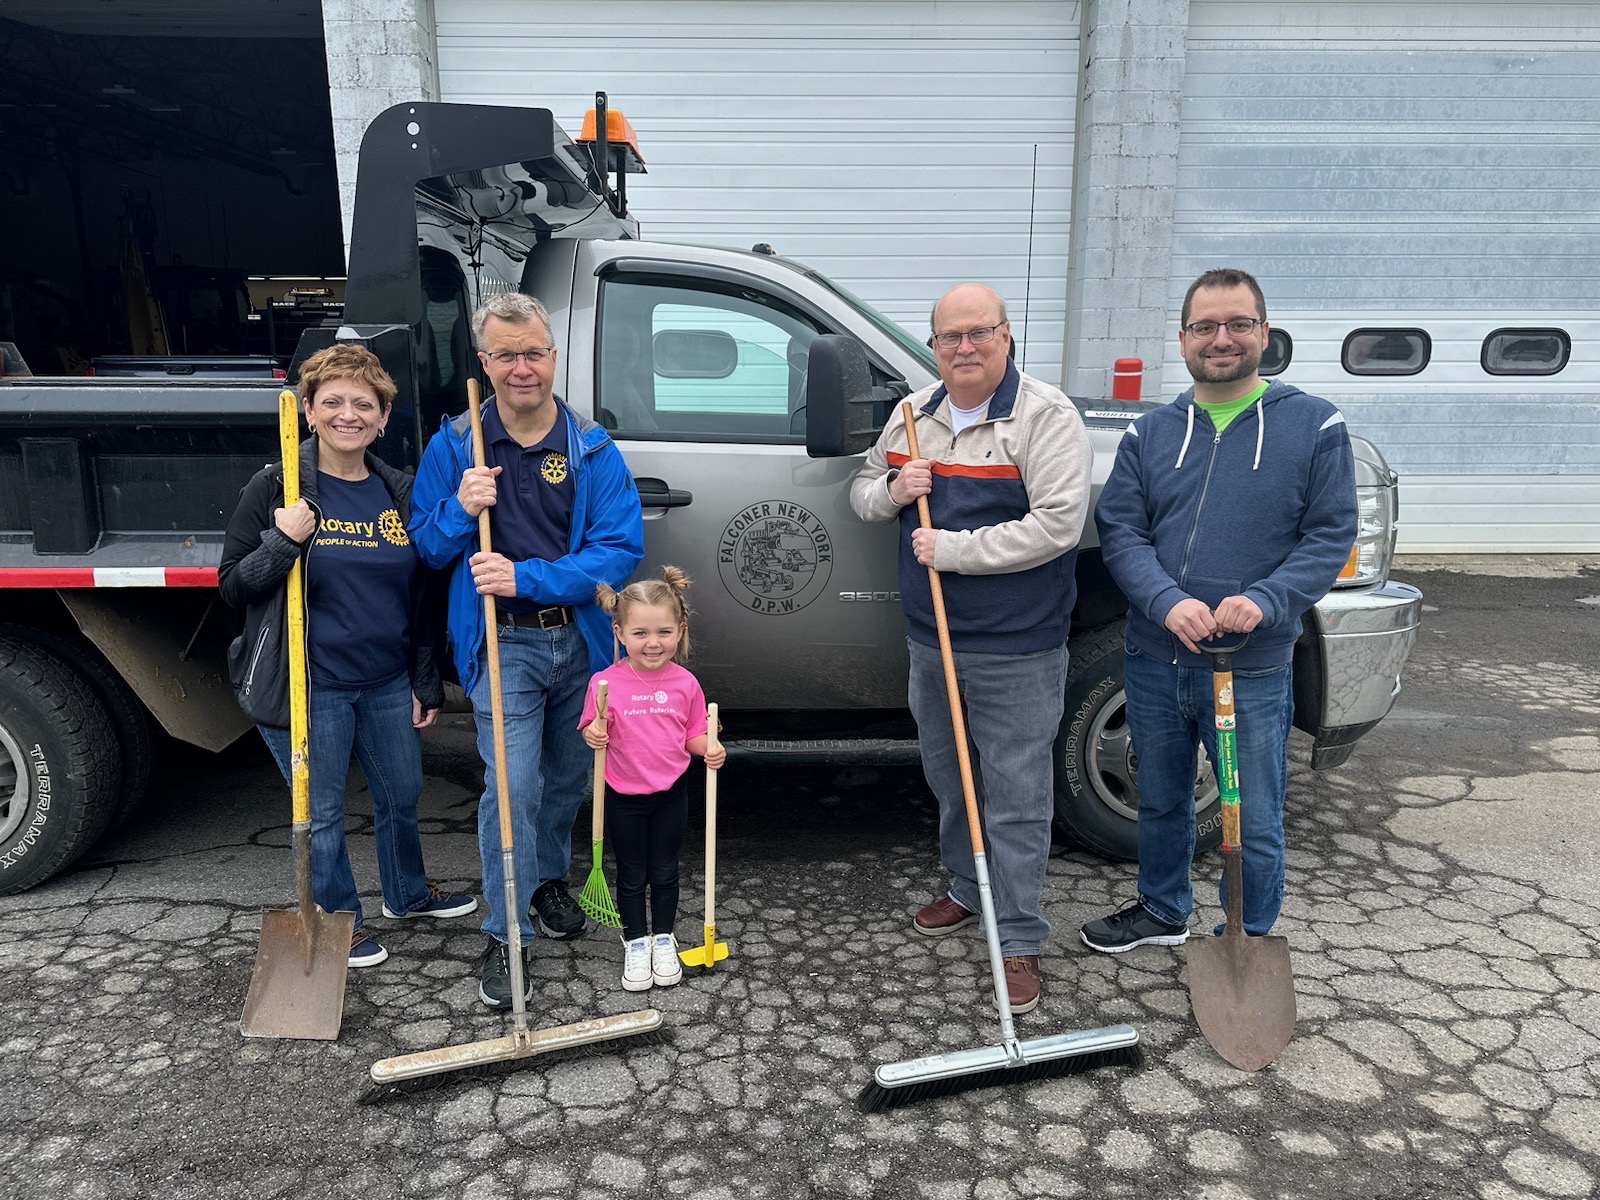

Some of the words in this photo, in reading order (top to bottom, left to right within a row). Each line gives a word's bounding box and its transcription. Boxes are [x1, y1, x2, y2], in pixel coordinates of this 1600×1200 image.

[720, 503, 771, 563] FALCONER
[778, 503, 811, 524] NEW
[810, 523, 831, 563] YORK
[316, 538, 345, 546] PEOPLE
[352, 540, 379, 548] ACTION
[751, 597, 801, 613] D.P.W.
[631, 694, 654, 702] Rotary
[623, 708, 647, 716] Future
[1065, 676, 1116, 797] TERRAMAX
[0, 743, 51, 869] TERRAMAX
